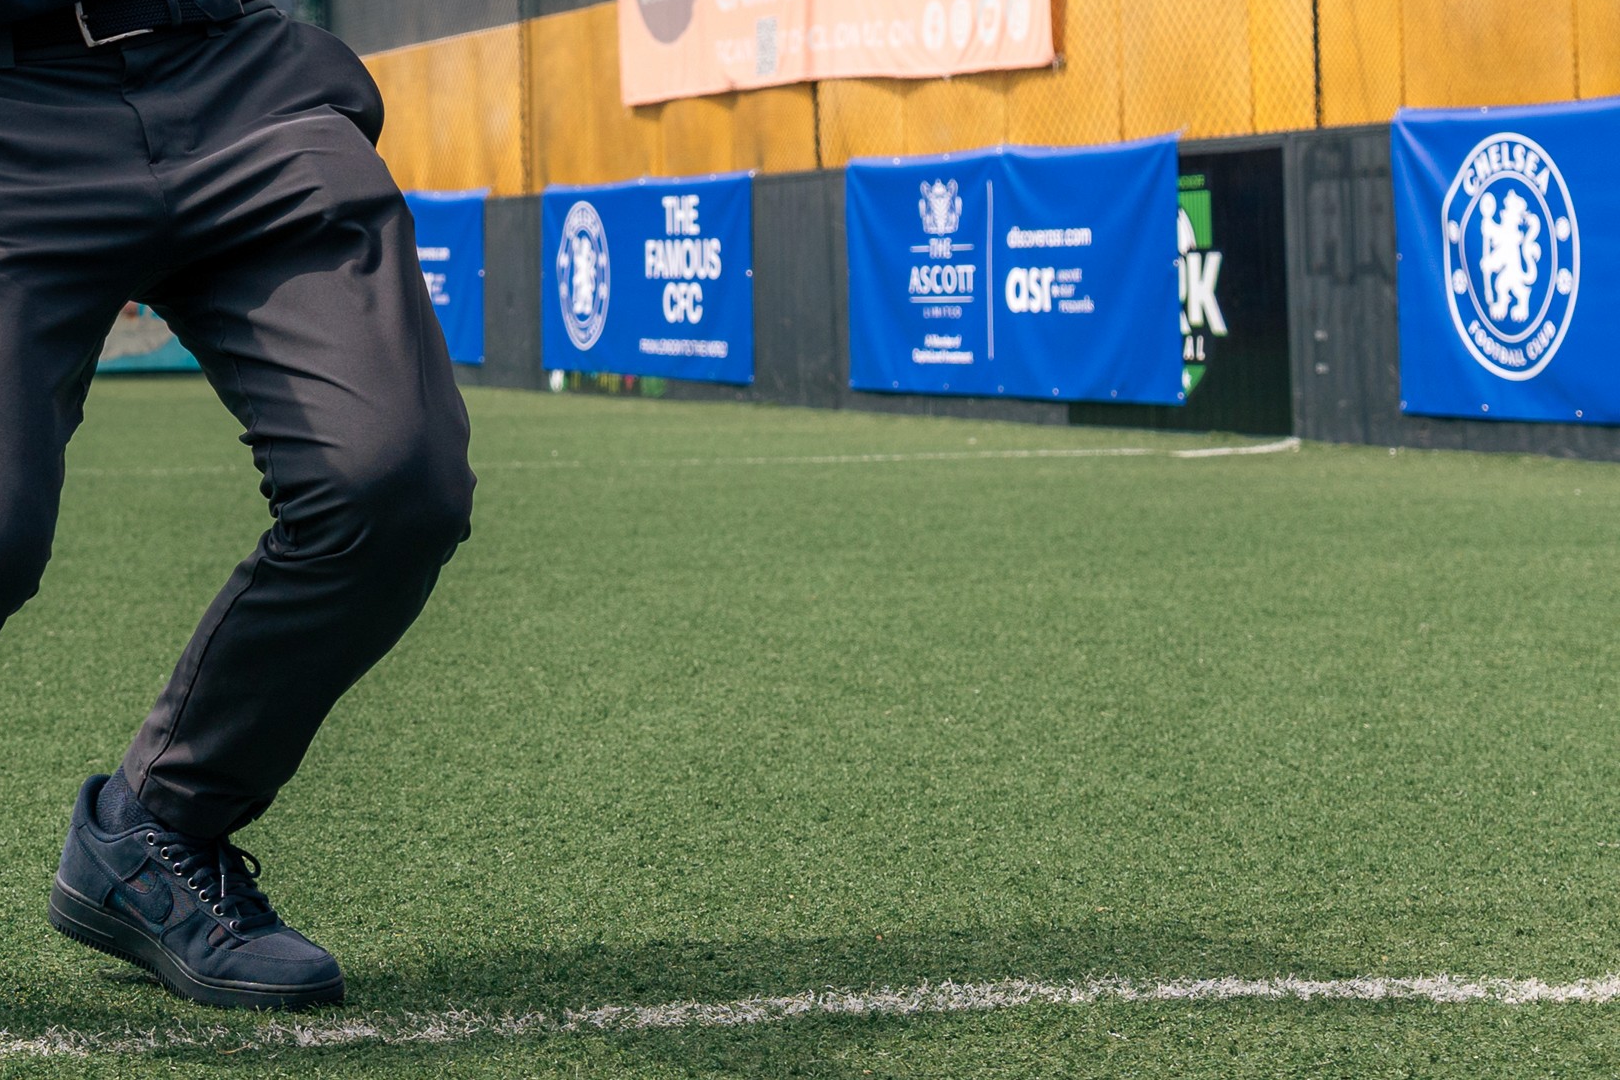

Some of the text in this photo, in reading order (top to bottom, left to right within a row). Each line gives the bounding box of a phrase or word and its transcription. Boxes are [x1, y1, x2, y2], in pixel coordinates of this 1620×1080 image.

[1462, 141, 1551, 197] CHELSEA
[661, 194, 701, 236] THE
[644, 237, 722, 281] FAMOUS
[929, 237, 953, 260] THE
[908, 264, 976, 295] ASCOTT
[1005, 266, 1055, 314] asr
[662, 281, 704, 325] CFC
[1467, 319, 1557, 367] FOOTBALL CLUB
